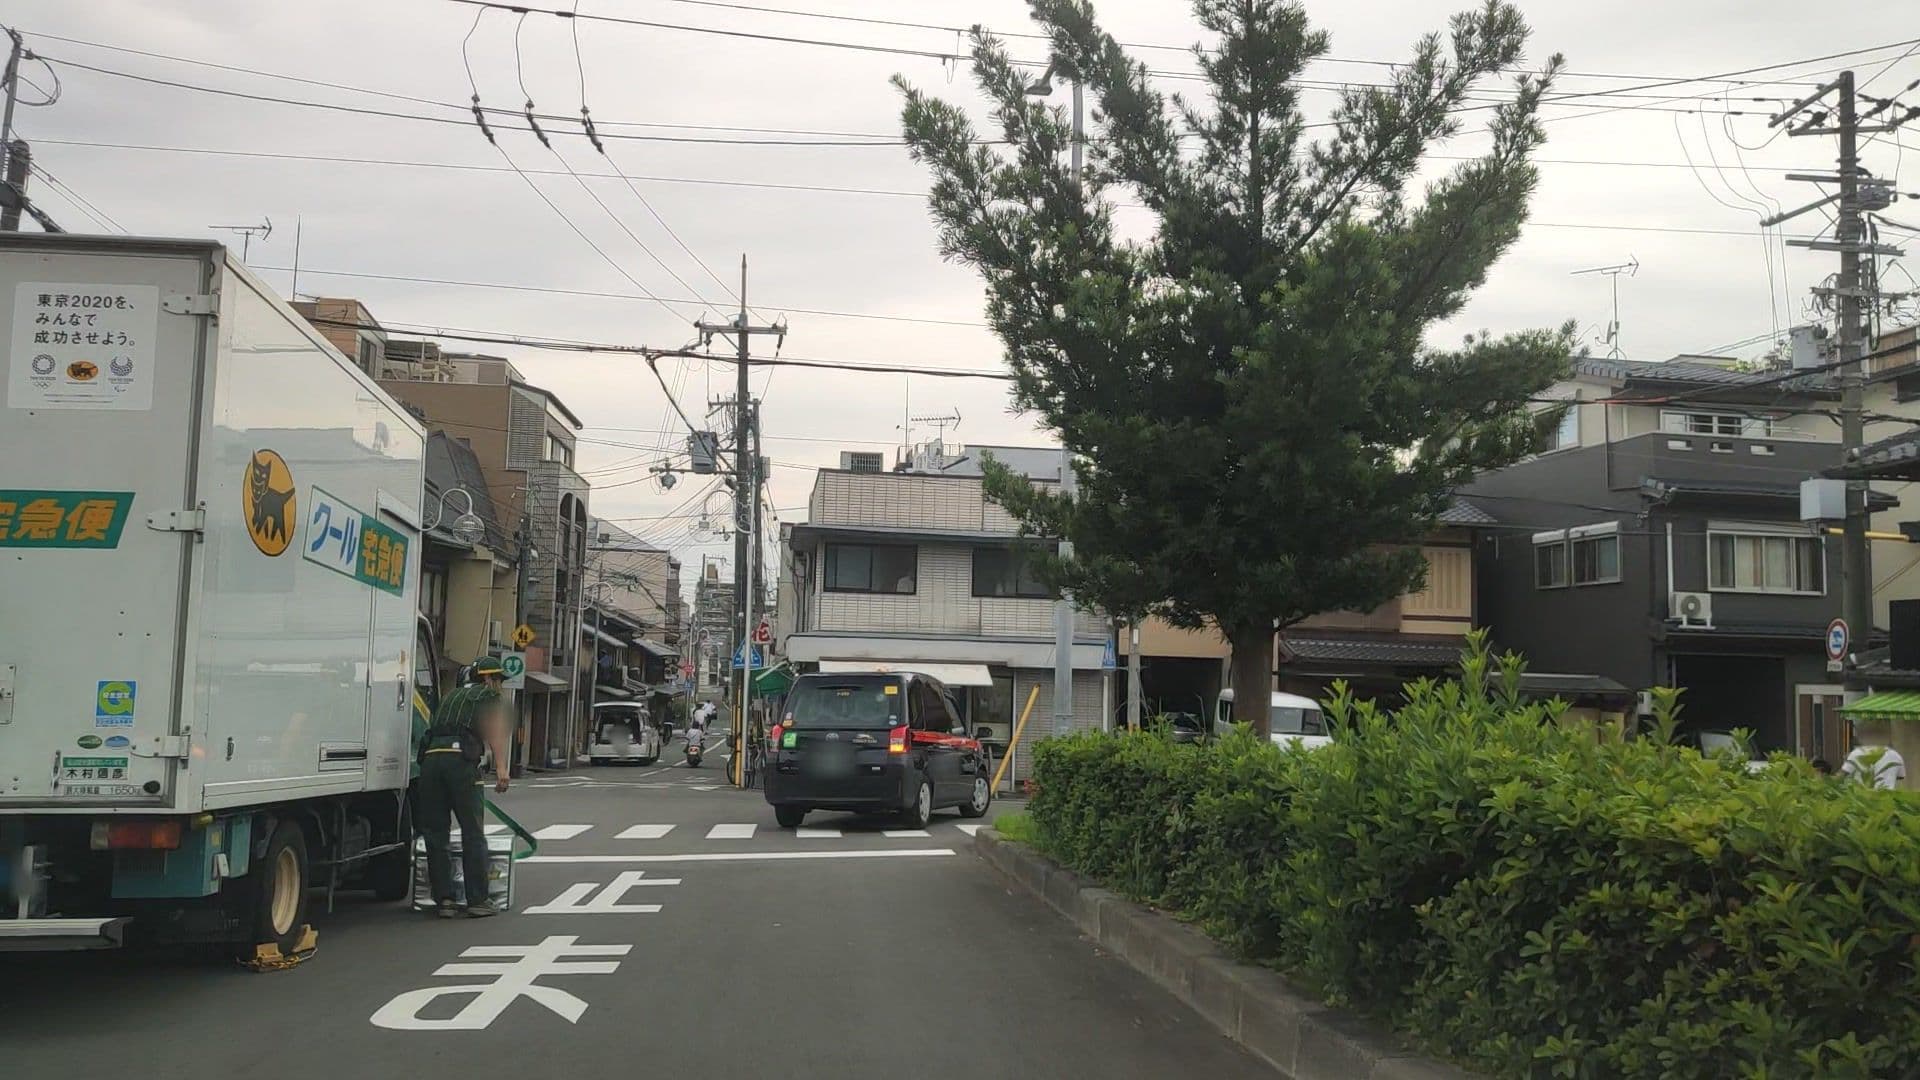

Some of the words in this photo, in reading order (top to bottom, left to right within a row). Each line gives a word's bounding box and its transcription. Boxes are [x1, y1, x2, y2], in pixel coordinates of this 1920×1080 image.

[37, 294, 135, 310] 東京2020を、
[35, 312, 97, 326] みんなで
[34, 330, 135, 347] 成功させよう。
